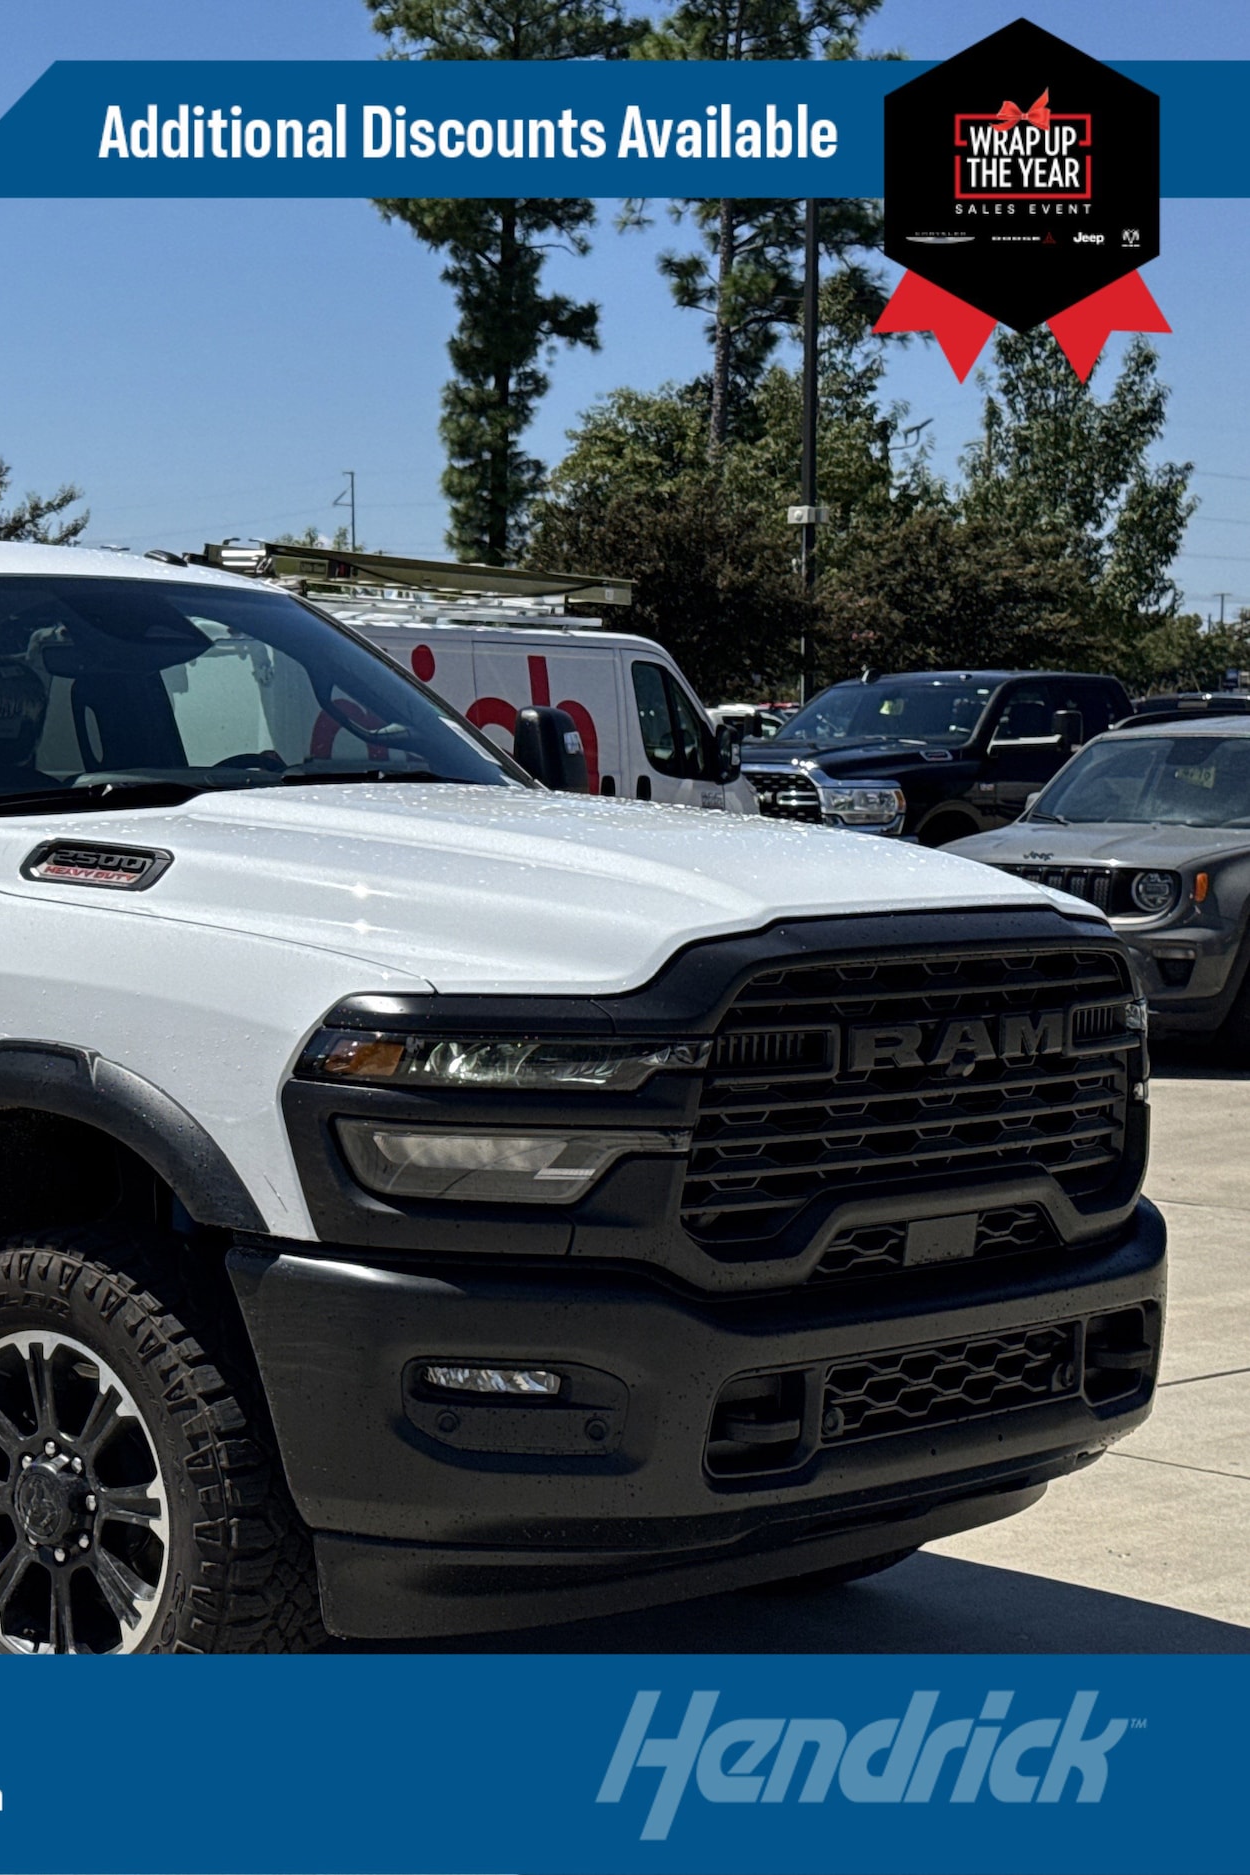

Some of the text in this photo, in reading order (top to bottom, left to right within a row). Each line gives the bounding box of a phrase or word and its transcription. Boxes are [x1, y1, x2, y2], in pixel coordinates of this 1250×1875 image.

[44, 865, 138, 882] HEAVY DUTY
[52, 850, 149, 875] 2500
[847, 1008, 1065, 1074] RAM
